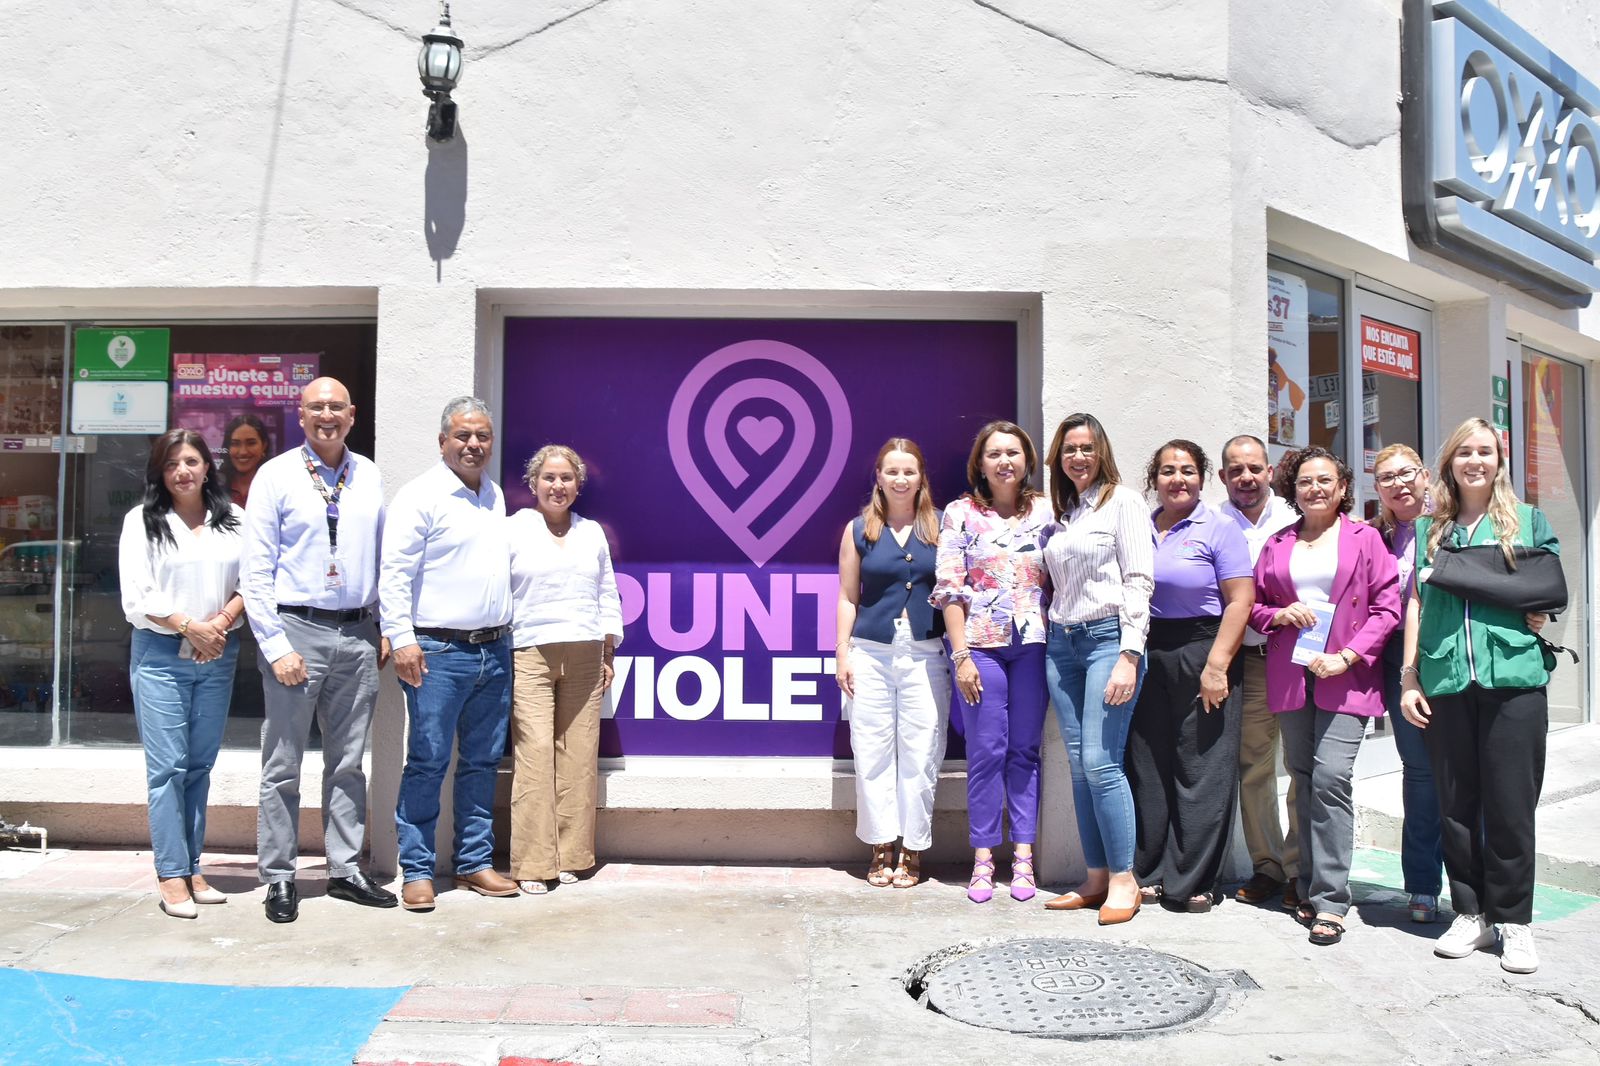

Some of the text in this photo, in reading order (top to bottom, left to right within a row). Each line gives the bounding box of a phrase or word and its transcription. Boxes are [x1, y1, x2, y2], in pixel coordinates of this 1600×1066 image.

[1366, 326, 1409, 351] NOS ENCANTA
[1363, 344, 1413, 372] QUE ESTÉS AQUÍ
[178, 366, 204, 376] OXXO
[208, 365, 284, 384] ¡Únete a
[179, 384, 247, 395] nuestro
[1036, 974, 1097, 989] CFE
